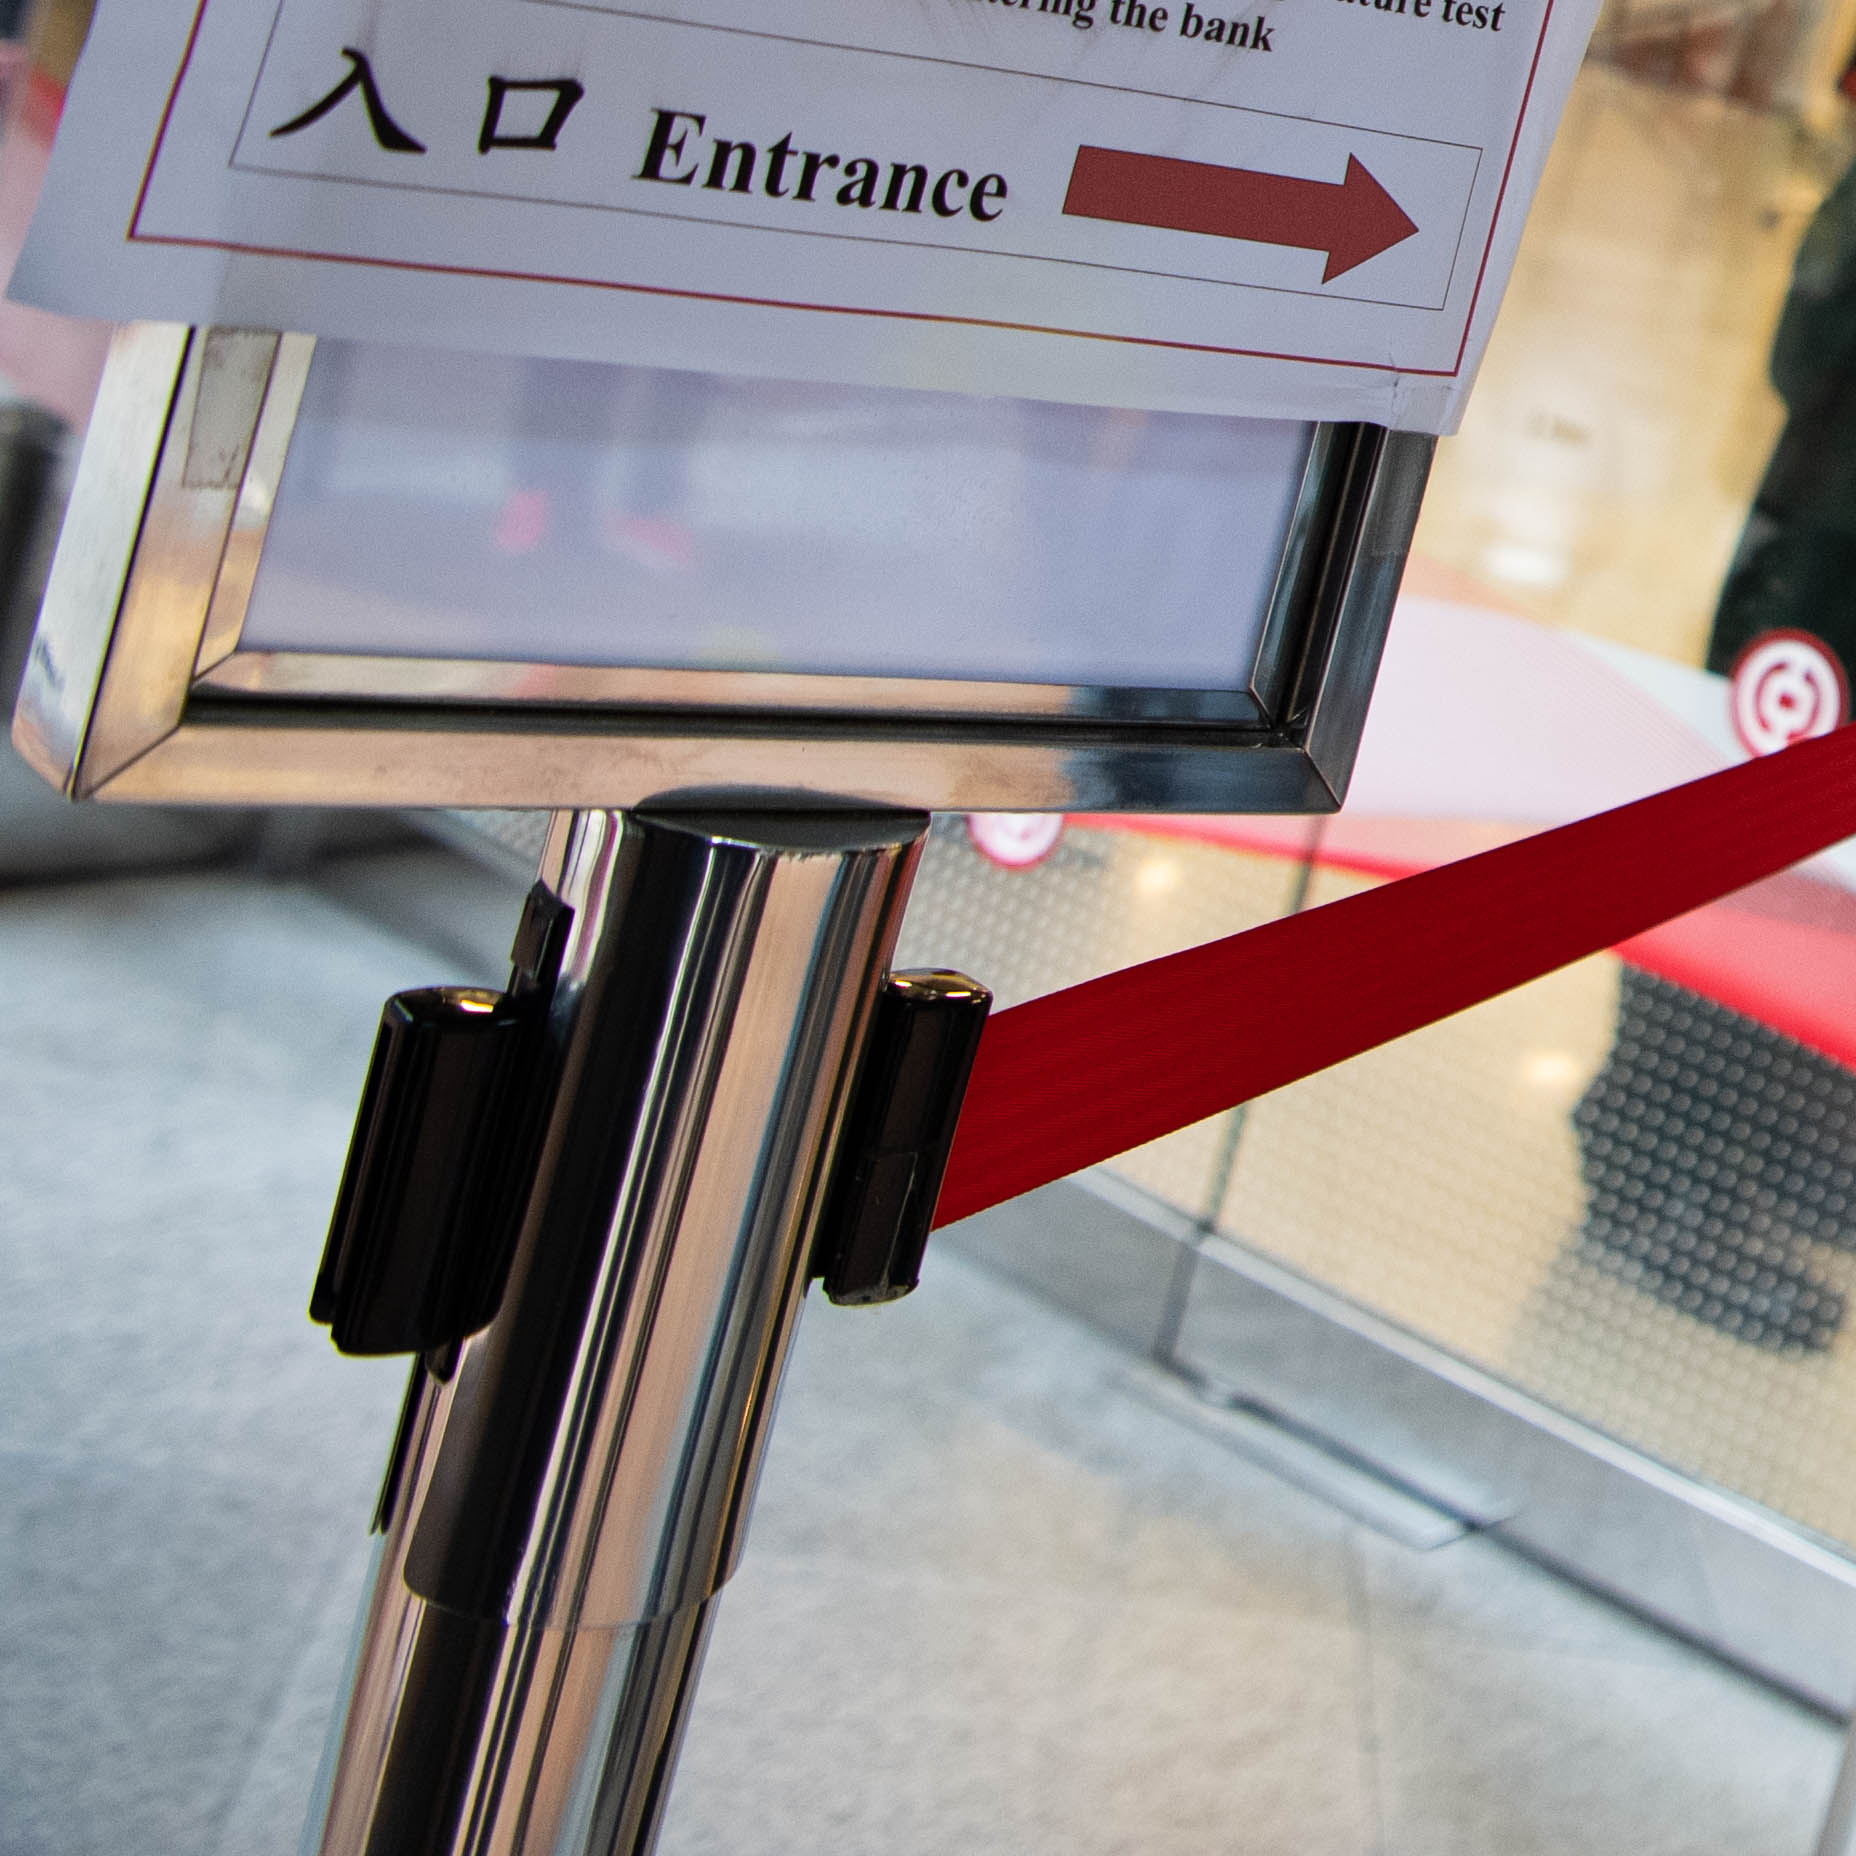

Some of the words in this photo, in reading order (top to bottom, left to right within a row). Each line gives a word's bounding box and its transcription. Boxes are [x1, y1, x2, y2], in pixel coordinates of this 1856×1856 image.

[1180, 2, 1274, 52] bank
[271, 47, 585, 155] 入口
[632, 108, 1008, 222] Entrance
